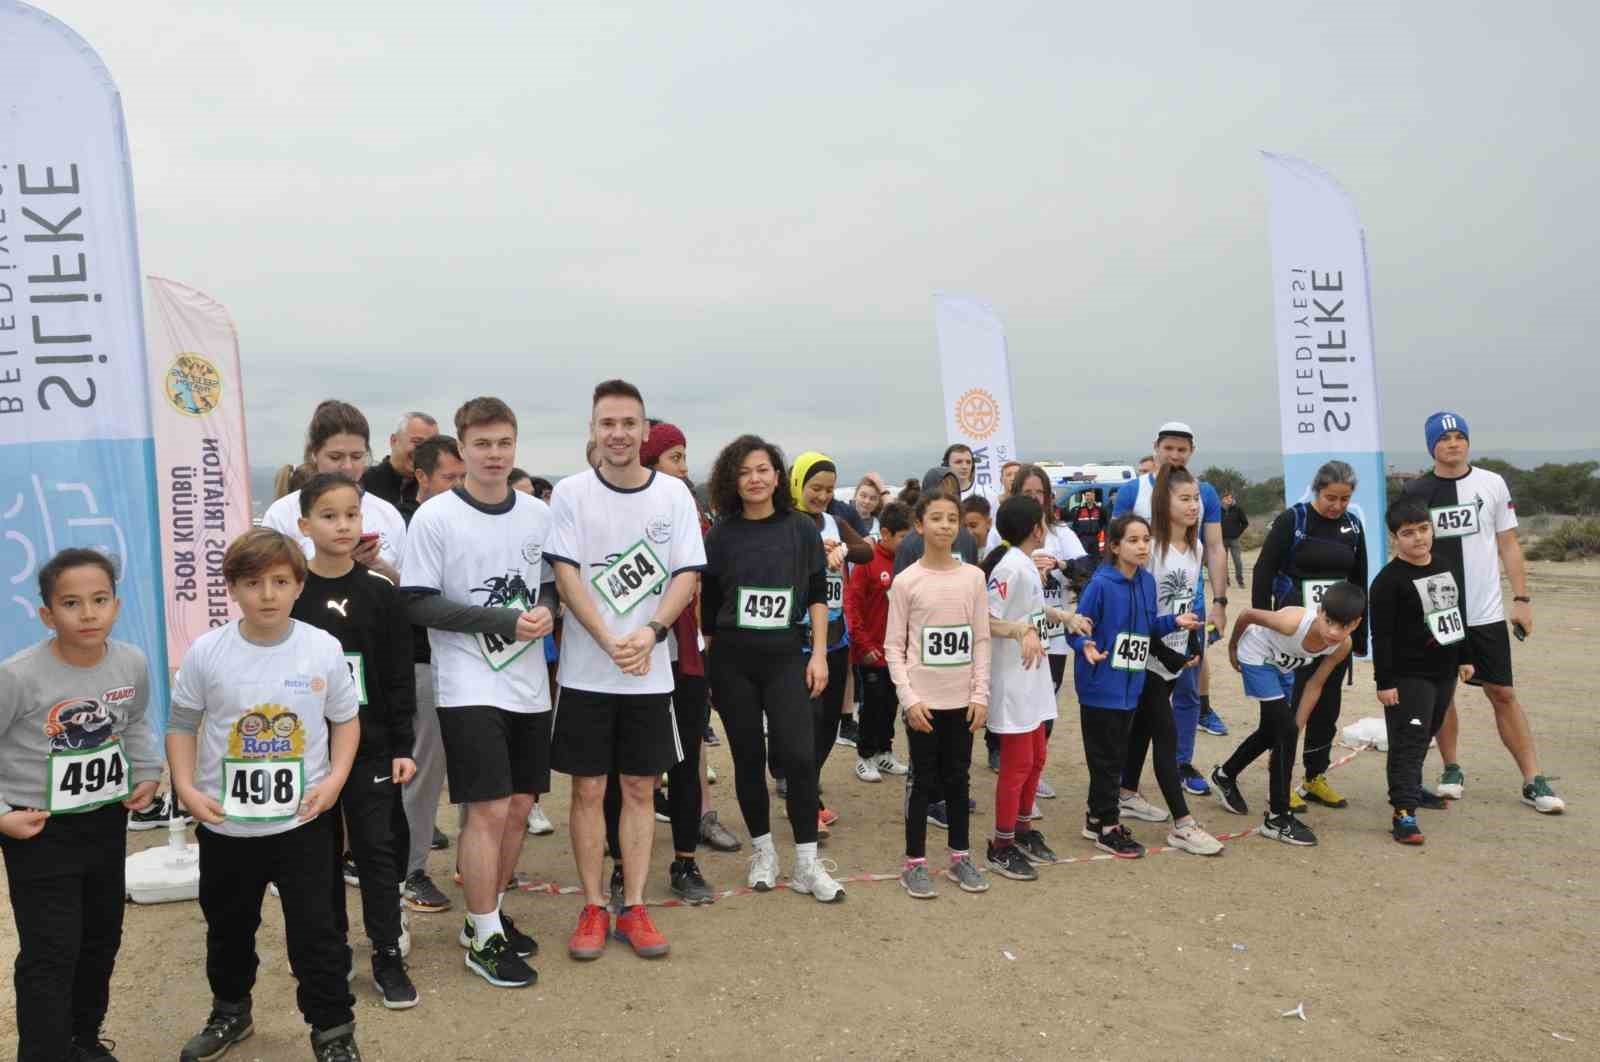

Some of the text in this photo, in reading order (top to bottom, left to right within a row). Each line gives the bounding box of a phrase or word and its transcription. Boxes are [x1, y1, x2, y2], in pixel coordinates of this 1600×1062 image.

[1437, 509, 1472, 530] 452
[607, 552, 656, 599] 464
[825, 582, 841, 600] 98
[744, 594, 786, 619] 492
[1438, 611, 1461, 635] 416
[927, 631, 969, 656] 394
[1116, 639, 1148, 662] 435
[242, 736, 292, 753] Rota
[60, 751, 124, 796] 494
[231, 769, 293, 804] 498
